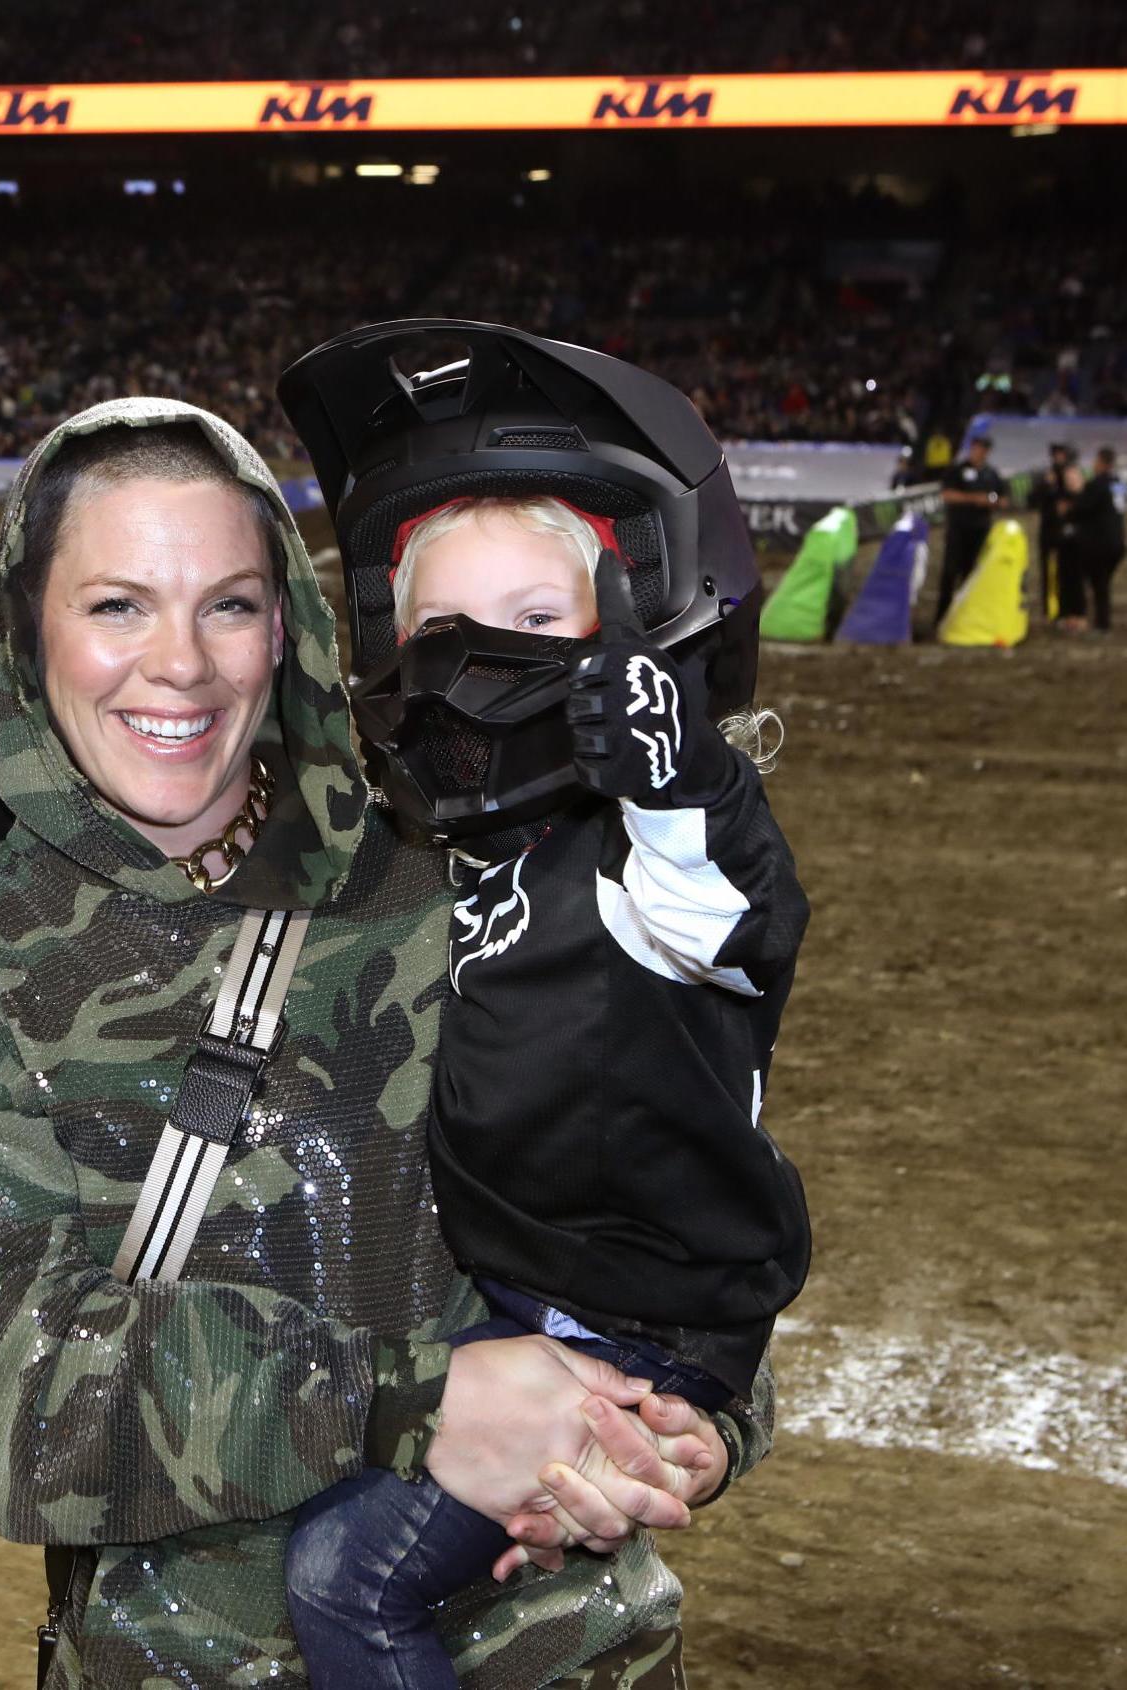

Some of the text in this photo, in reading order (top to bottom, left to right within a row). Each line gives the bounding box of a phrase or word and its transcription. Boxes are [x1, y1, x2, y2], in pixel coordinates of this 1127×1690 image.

[260, 81, 372, 122] KTM
[593, 75, 714, 119] KTM
[948, 71, 1078, 115] KTM
